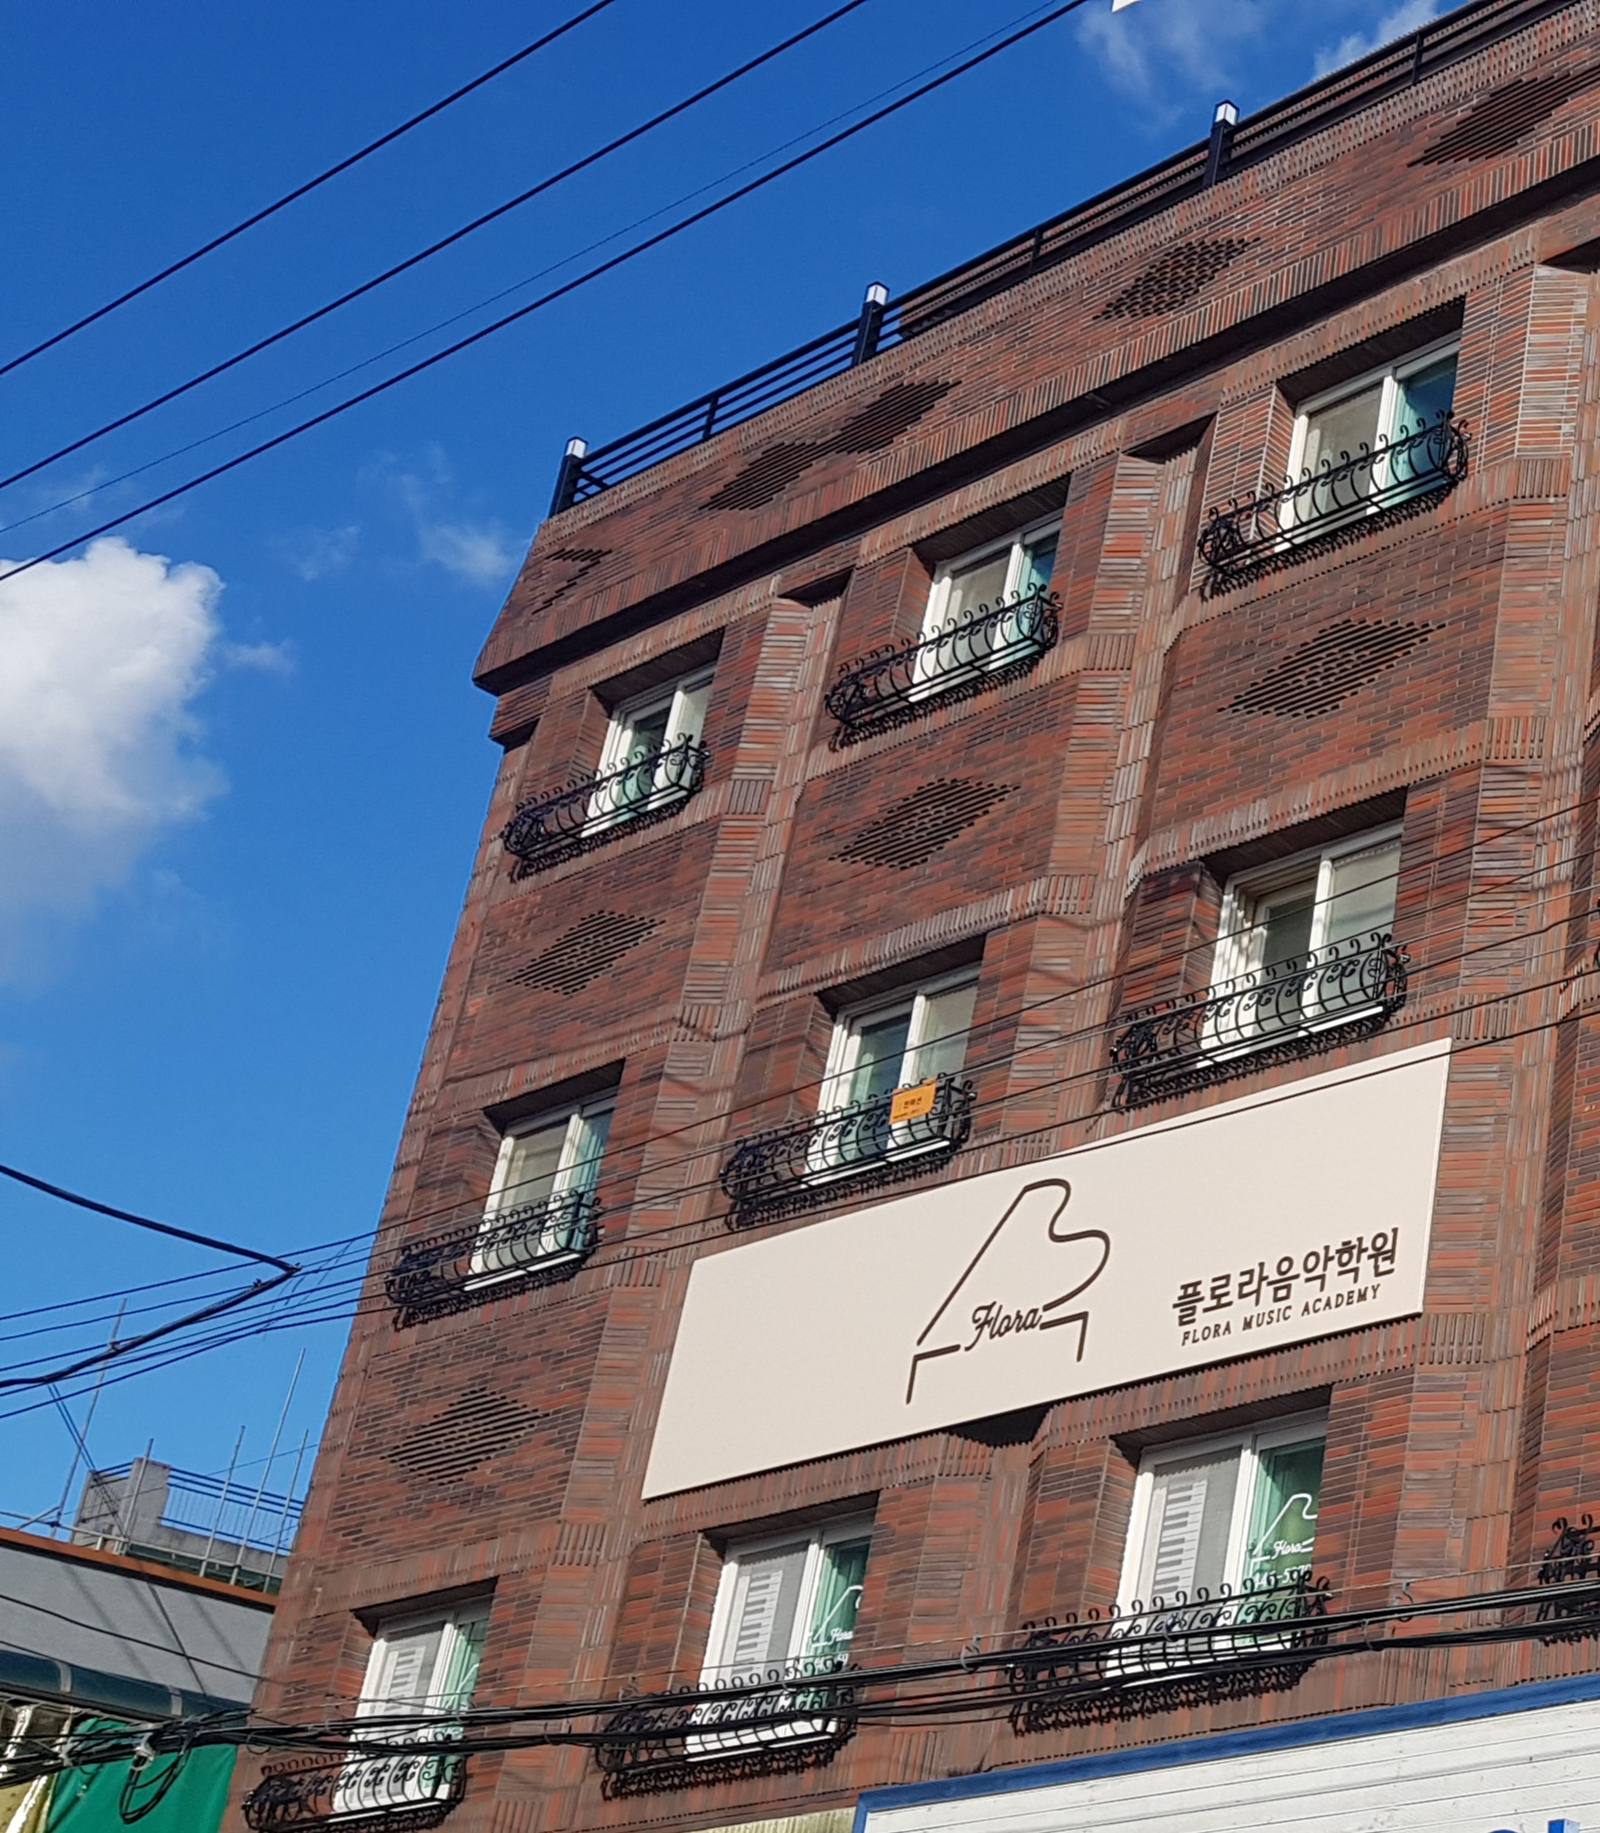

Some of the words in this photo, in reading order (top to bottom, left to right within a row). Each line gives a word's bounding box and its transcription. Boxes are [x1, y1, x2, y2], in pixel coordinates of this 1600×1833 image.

[1172, 1227, 1399, 1327] 플로라음악학원
[964, 1301, 1043, 1352] Flora
[1181, 1321, 1232, 1346] FLORA
[1242, 1305, 1293, 1331] MUSIC
[1301, 1283, 1381, 1317] ACADEMY
